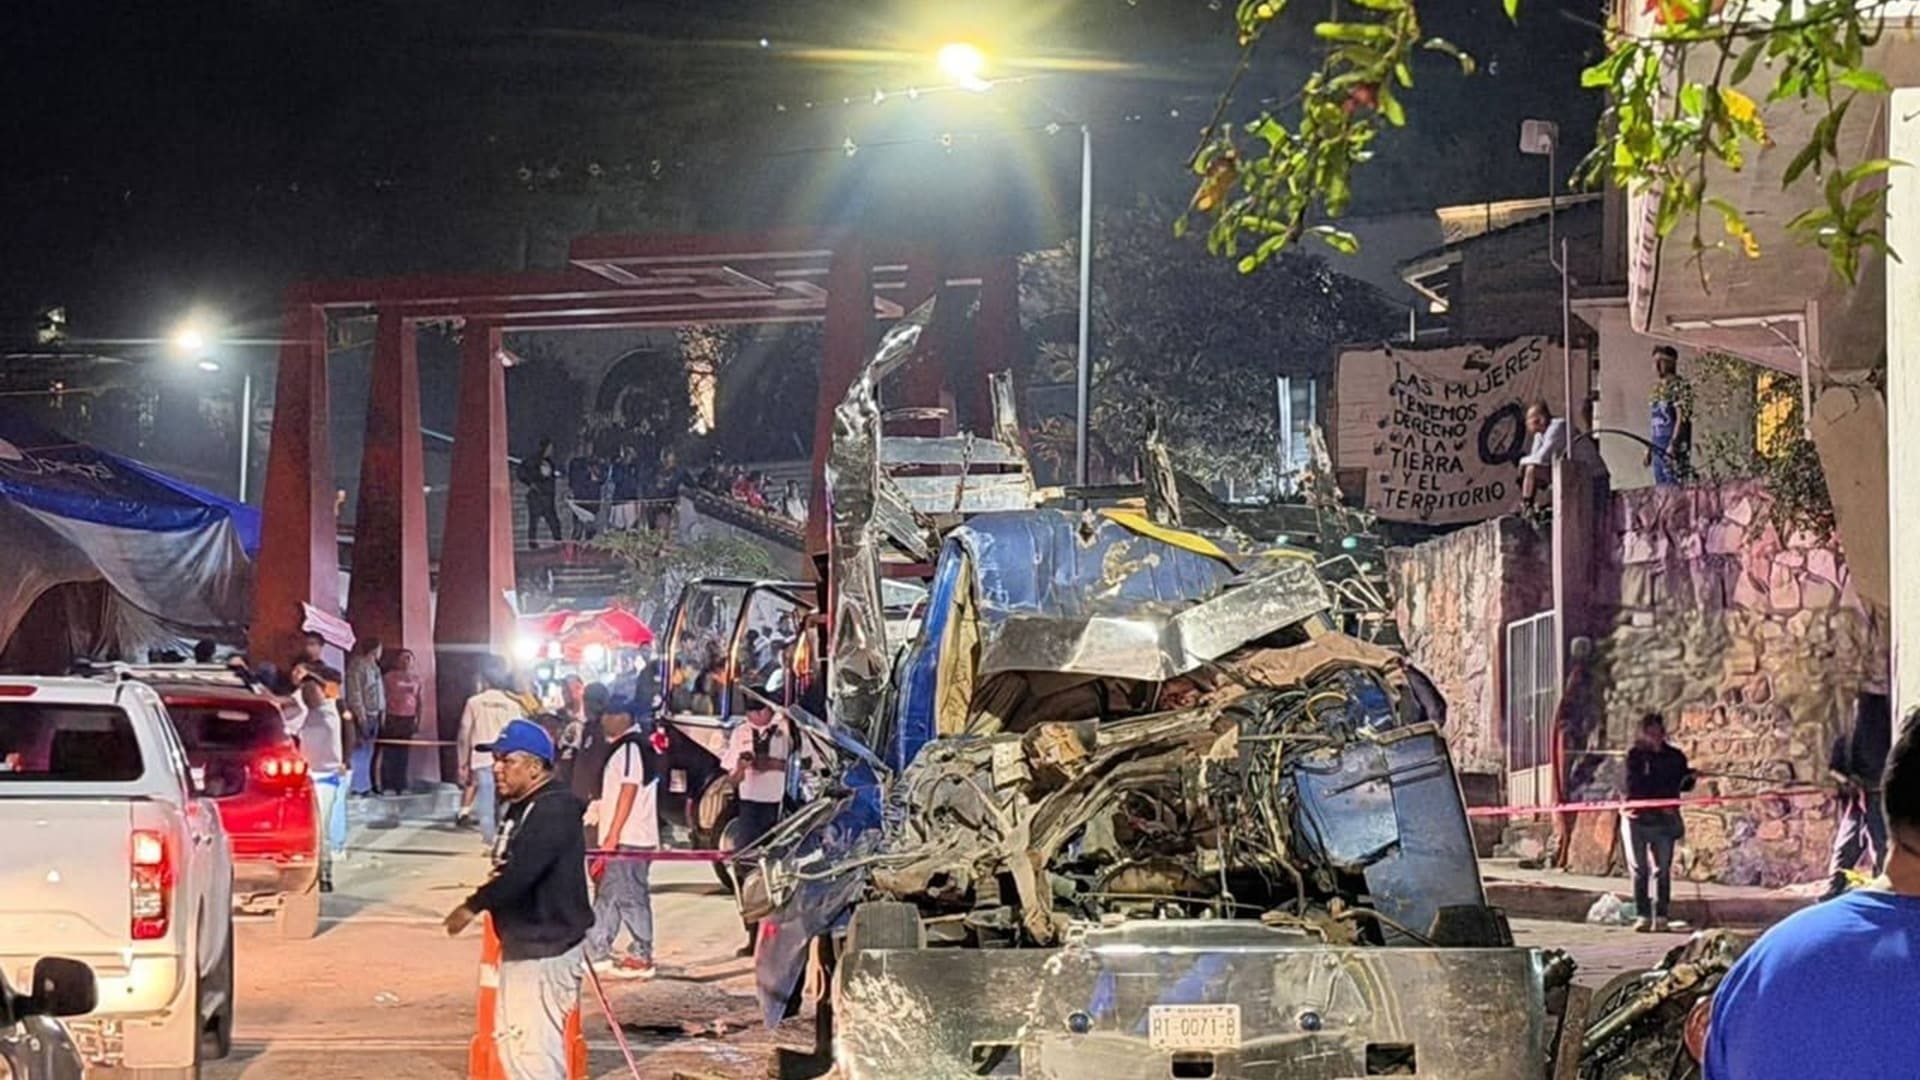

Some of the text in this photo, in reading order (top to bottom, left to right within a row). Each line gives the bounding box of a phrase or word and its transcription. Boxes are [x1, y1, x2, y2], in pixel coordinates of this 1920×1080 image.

[1396, 339, 1542, 400] LAS MUJERES
[1398, 390, 1478, 421] TENEMOS
[1394, 409, 1467, 438] DERECHO
[1404, 434, 1447, 453] A LA
[1390, 447, 1464, 473] TIERRA
[1402, 472, 1441, 491] Y EL
